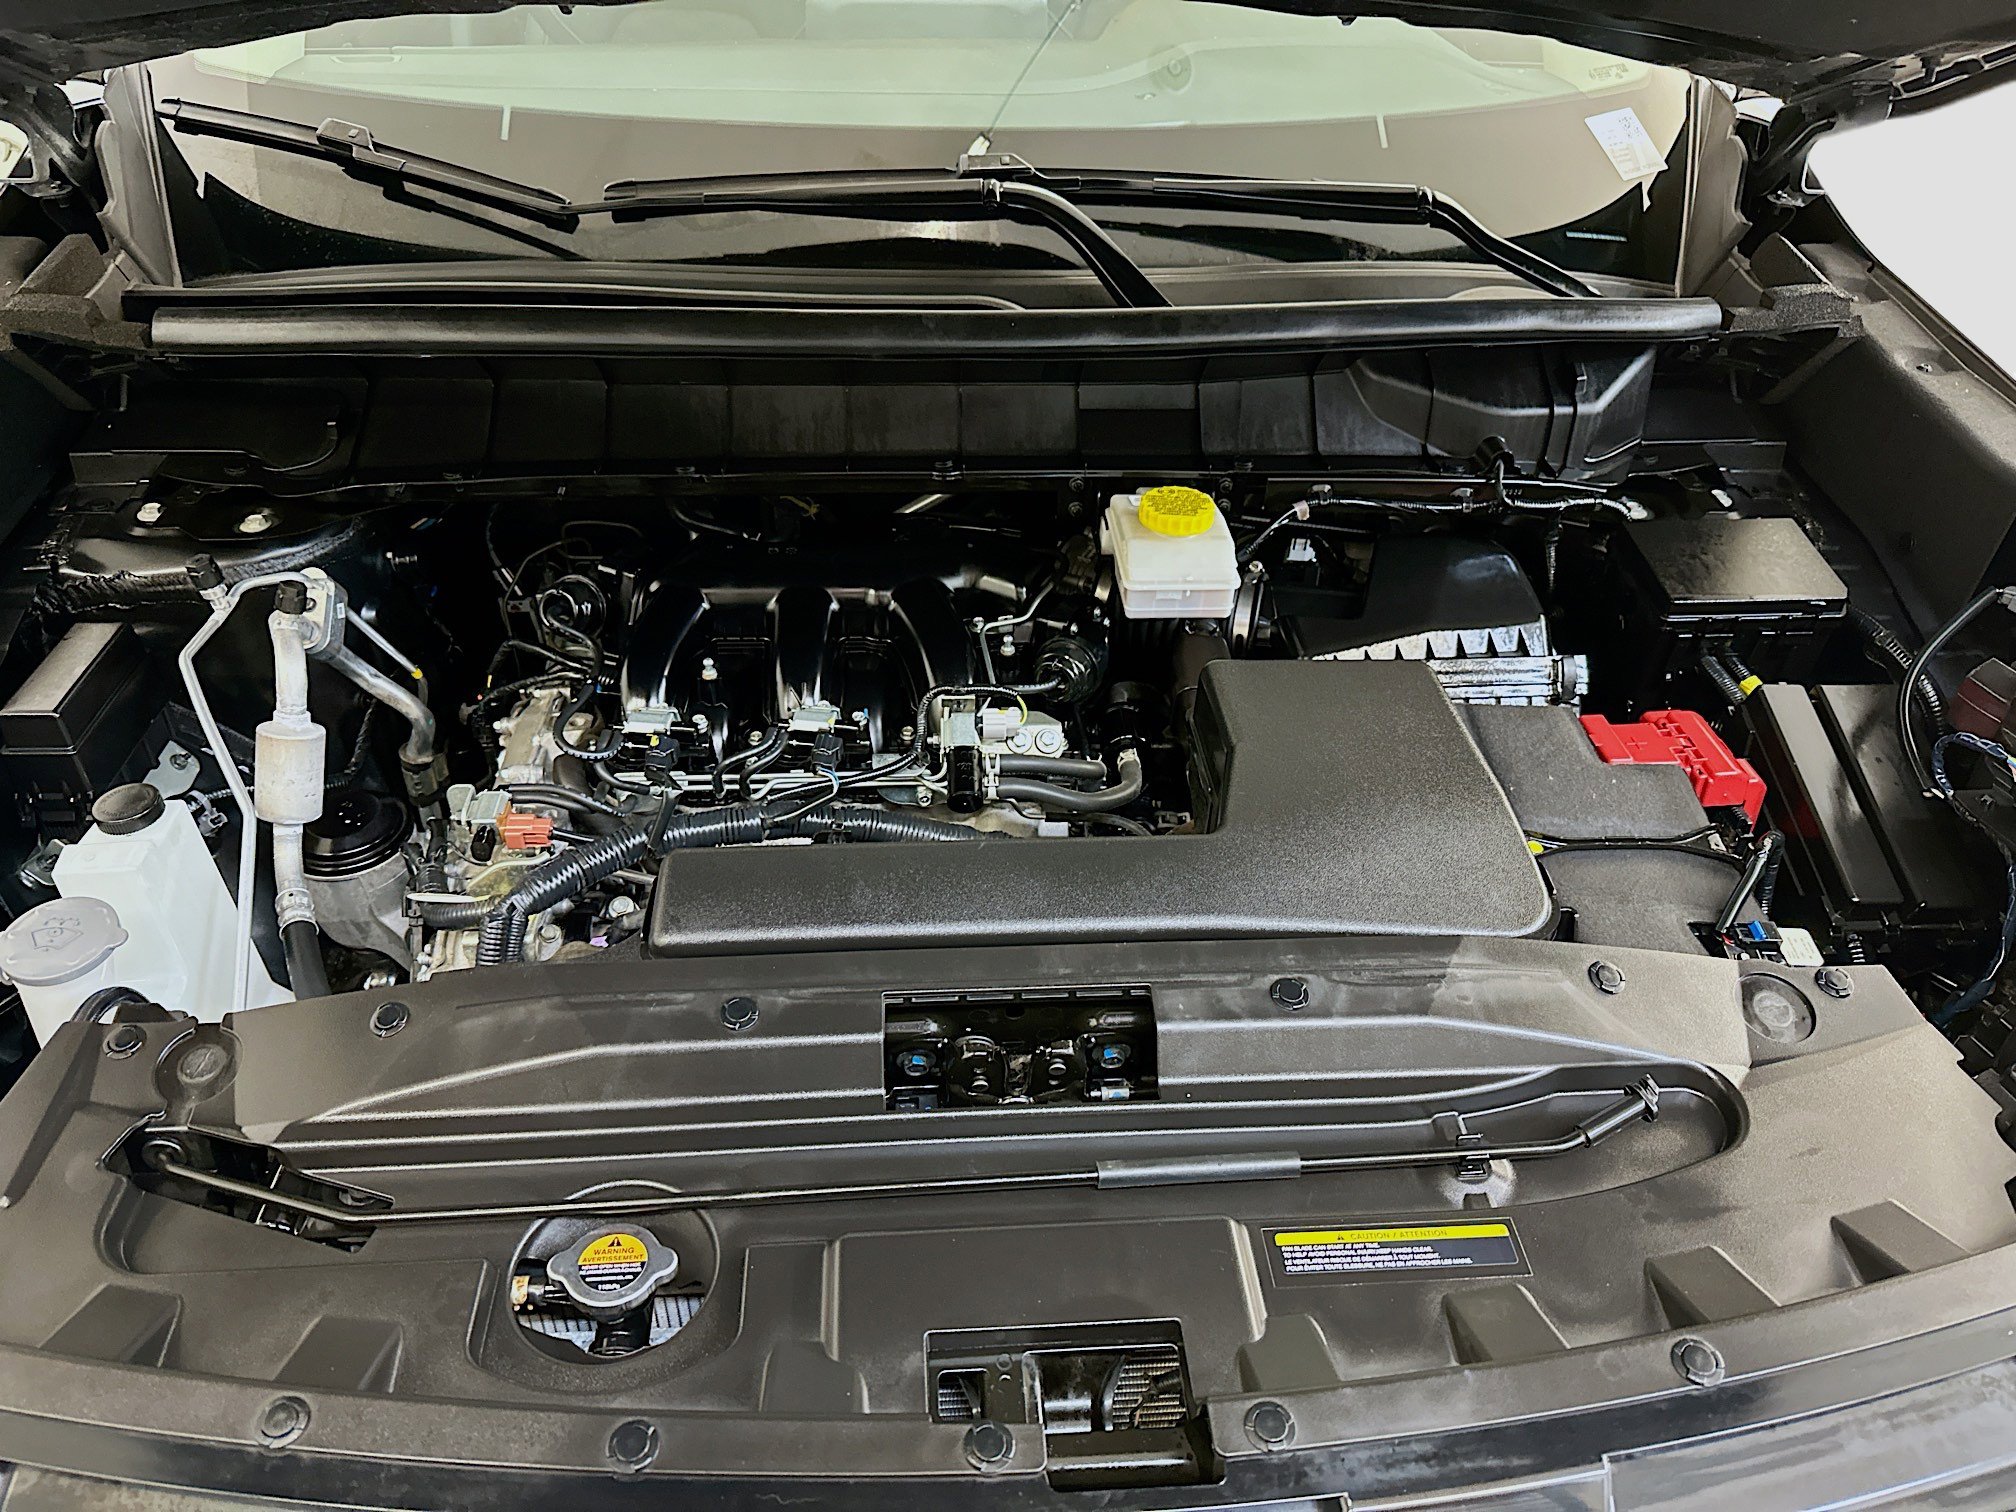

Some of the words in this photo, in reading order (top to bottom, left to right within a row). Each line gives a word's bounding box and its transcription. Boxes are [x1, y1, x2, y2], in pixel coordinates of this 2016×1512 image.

[1351, 1232, 1389, 1240] CAUTION
[1400, 1230, 1447, 1238] ATTENTION
[594, 1247, 634, 1255] WARNING
[582, 1254, 644, 1262] AVERTISSEMENT
